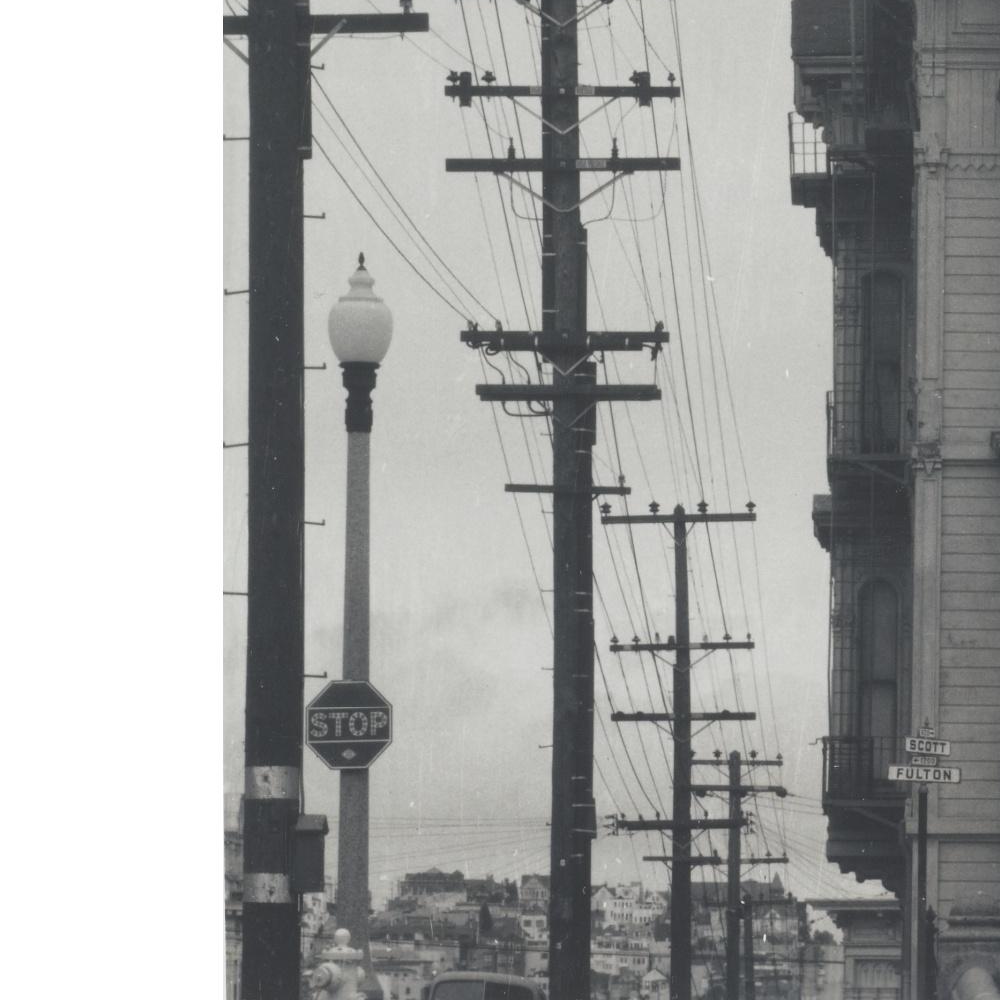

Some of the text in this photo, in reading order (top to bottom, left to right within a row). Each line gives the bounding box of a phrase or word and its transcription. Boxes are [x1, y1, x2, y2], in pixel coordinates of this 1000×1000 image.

[310, 711, 388, 737] STOP
[909, 740, 947, 753] SCOTT
[896, 768, 952, 781] FULTON
